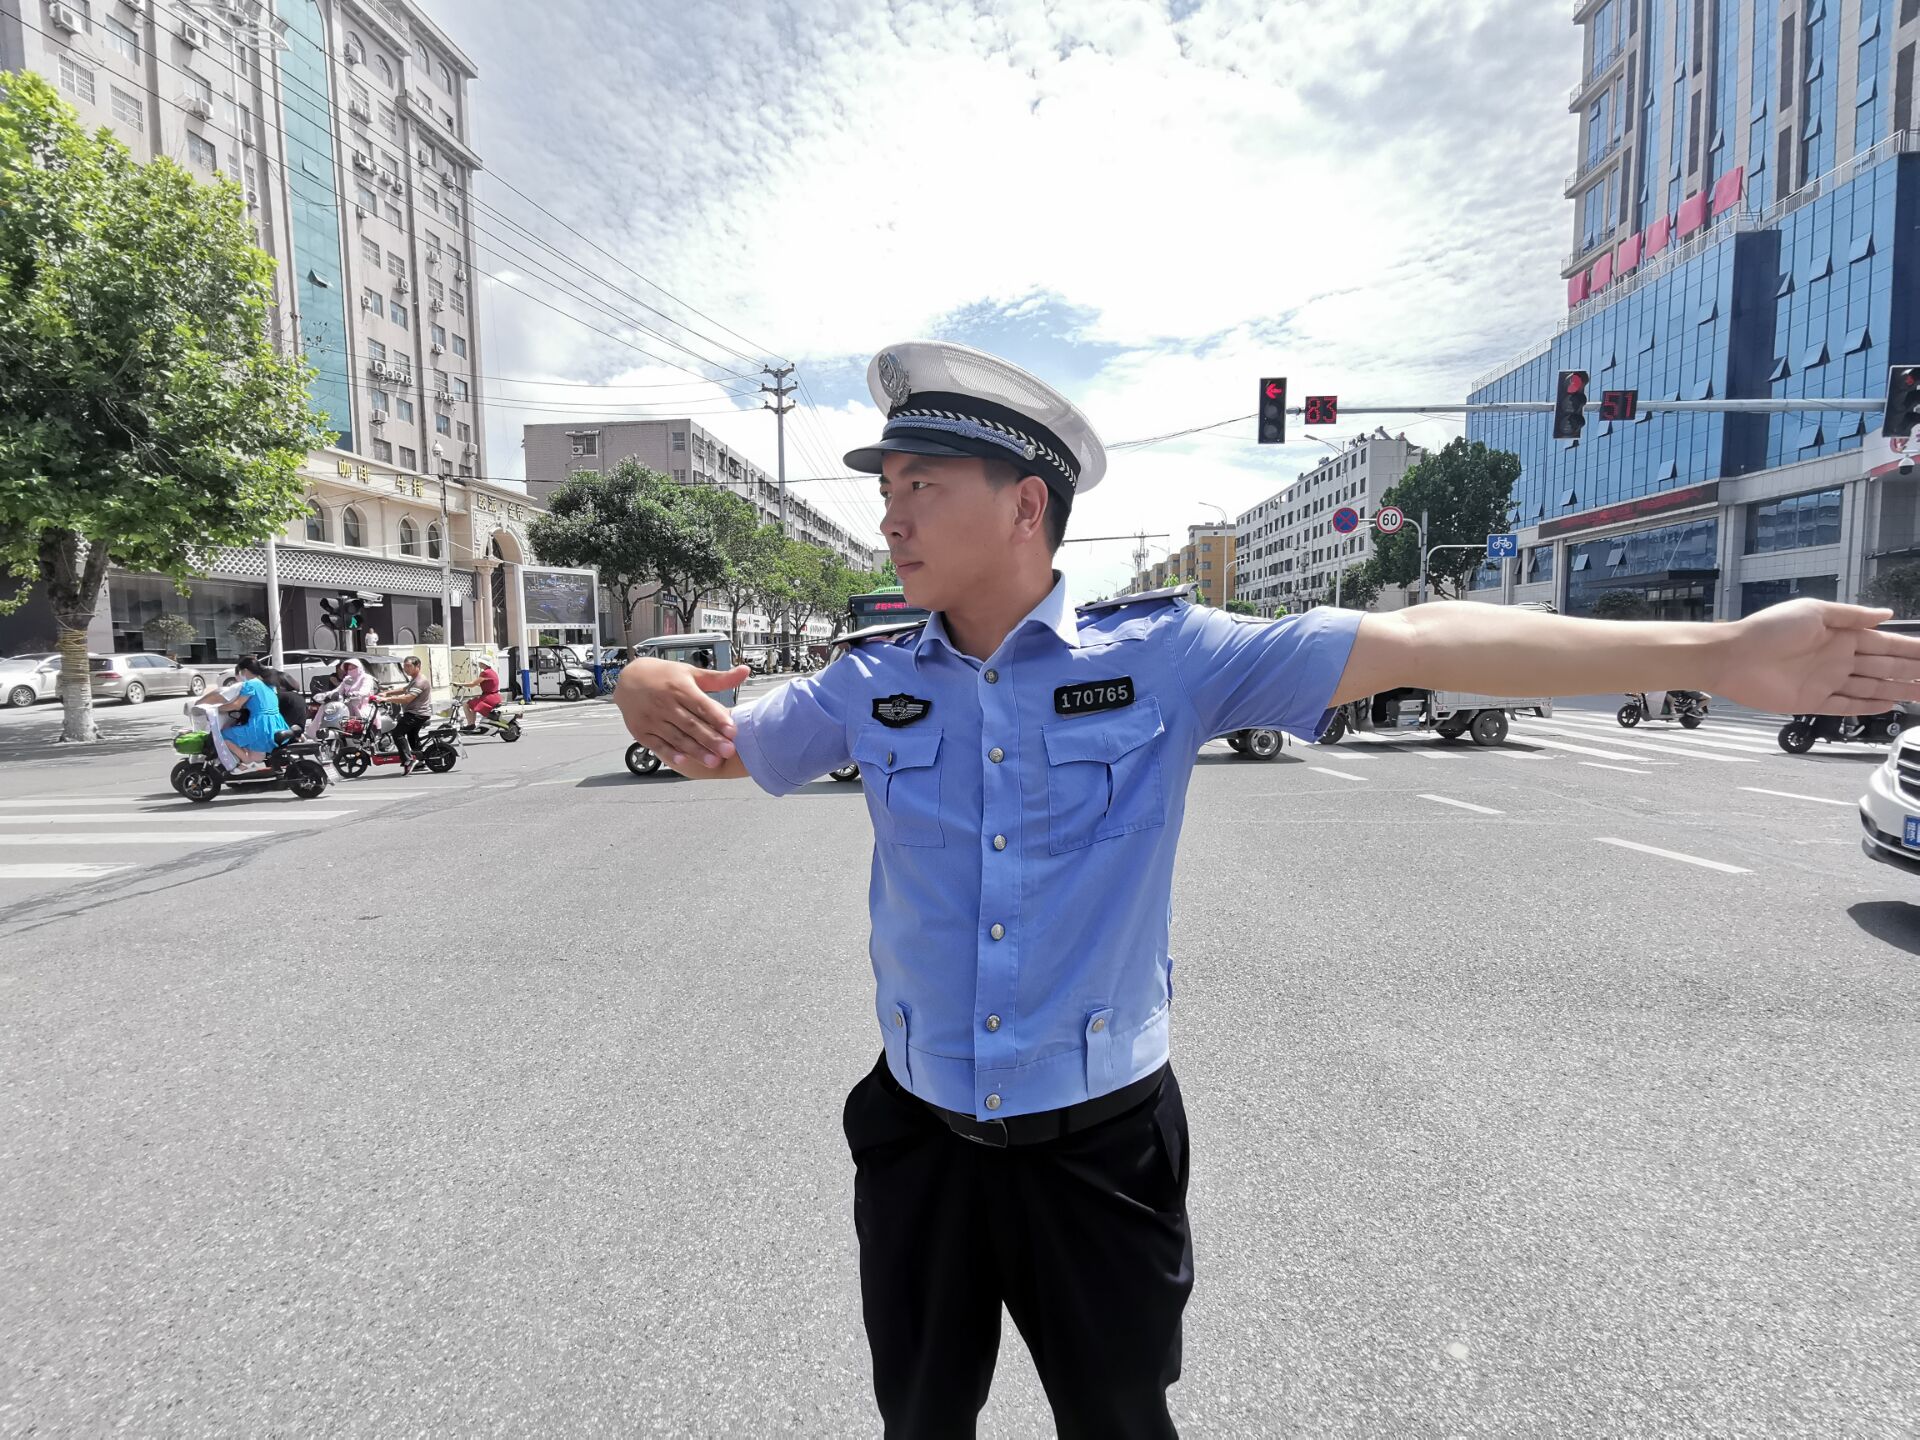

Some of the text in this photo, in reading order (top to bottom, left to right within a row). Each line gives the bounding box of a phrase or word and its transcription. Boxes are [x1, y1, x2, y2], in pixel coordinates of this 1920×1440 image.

[1307, 396, 1337, 423] 83
[1603, 391, 1634, 420] 51
[337, 458, 425, 498] 咖啡 牛排
[1382, 513, 1398, 526] 60
[1061, 684, 1129, 709] 170765
